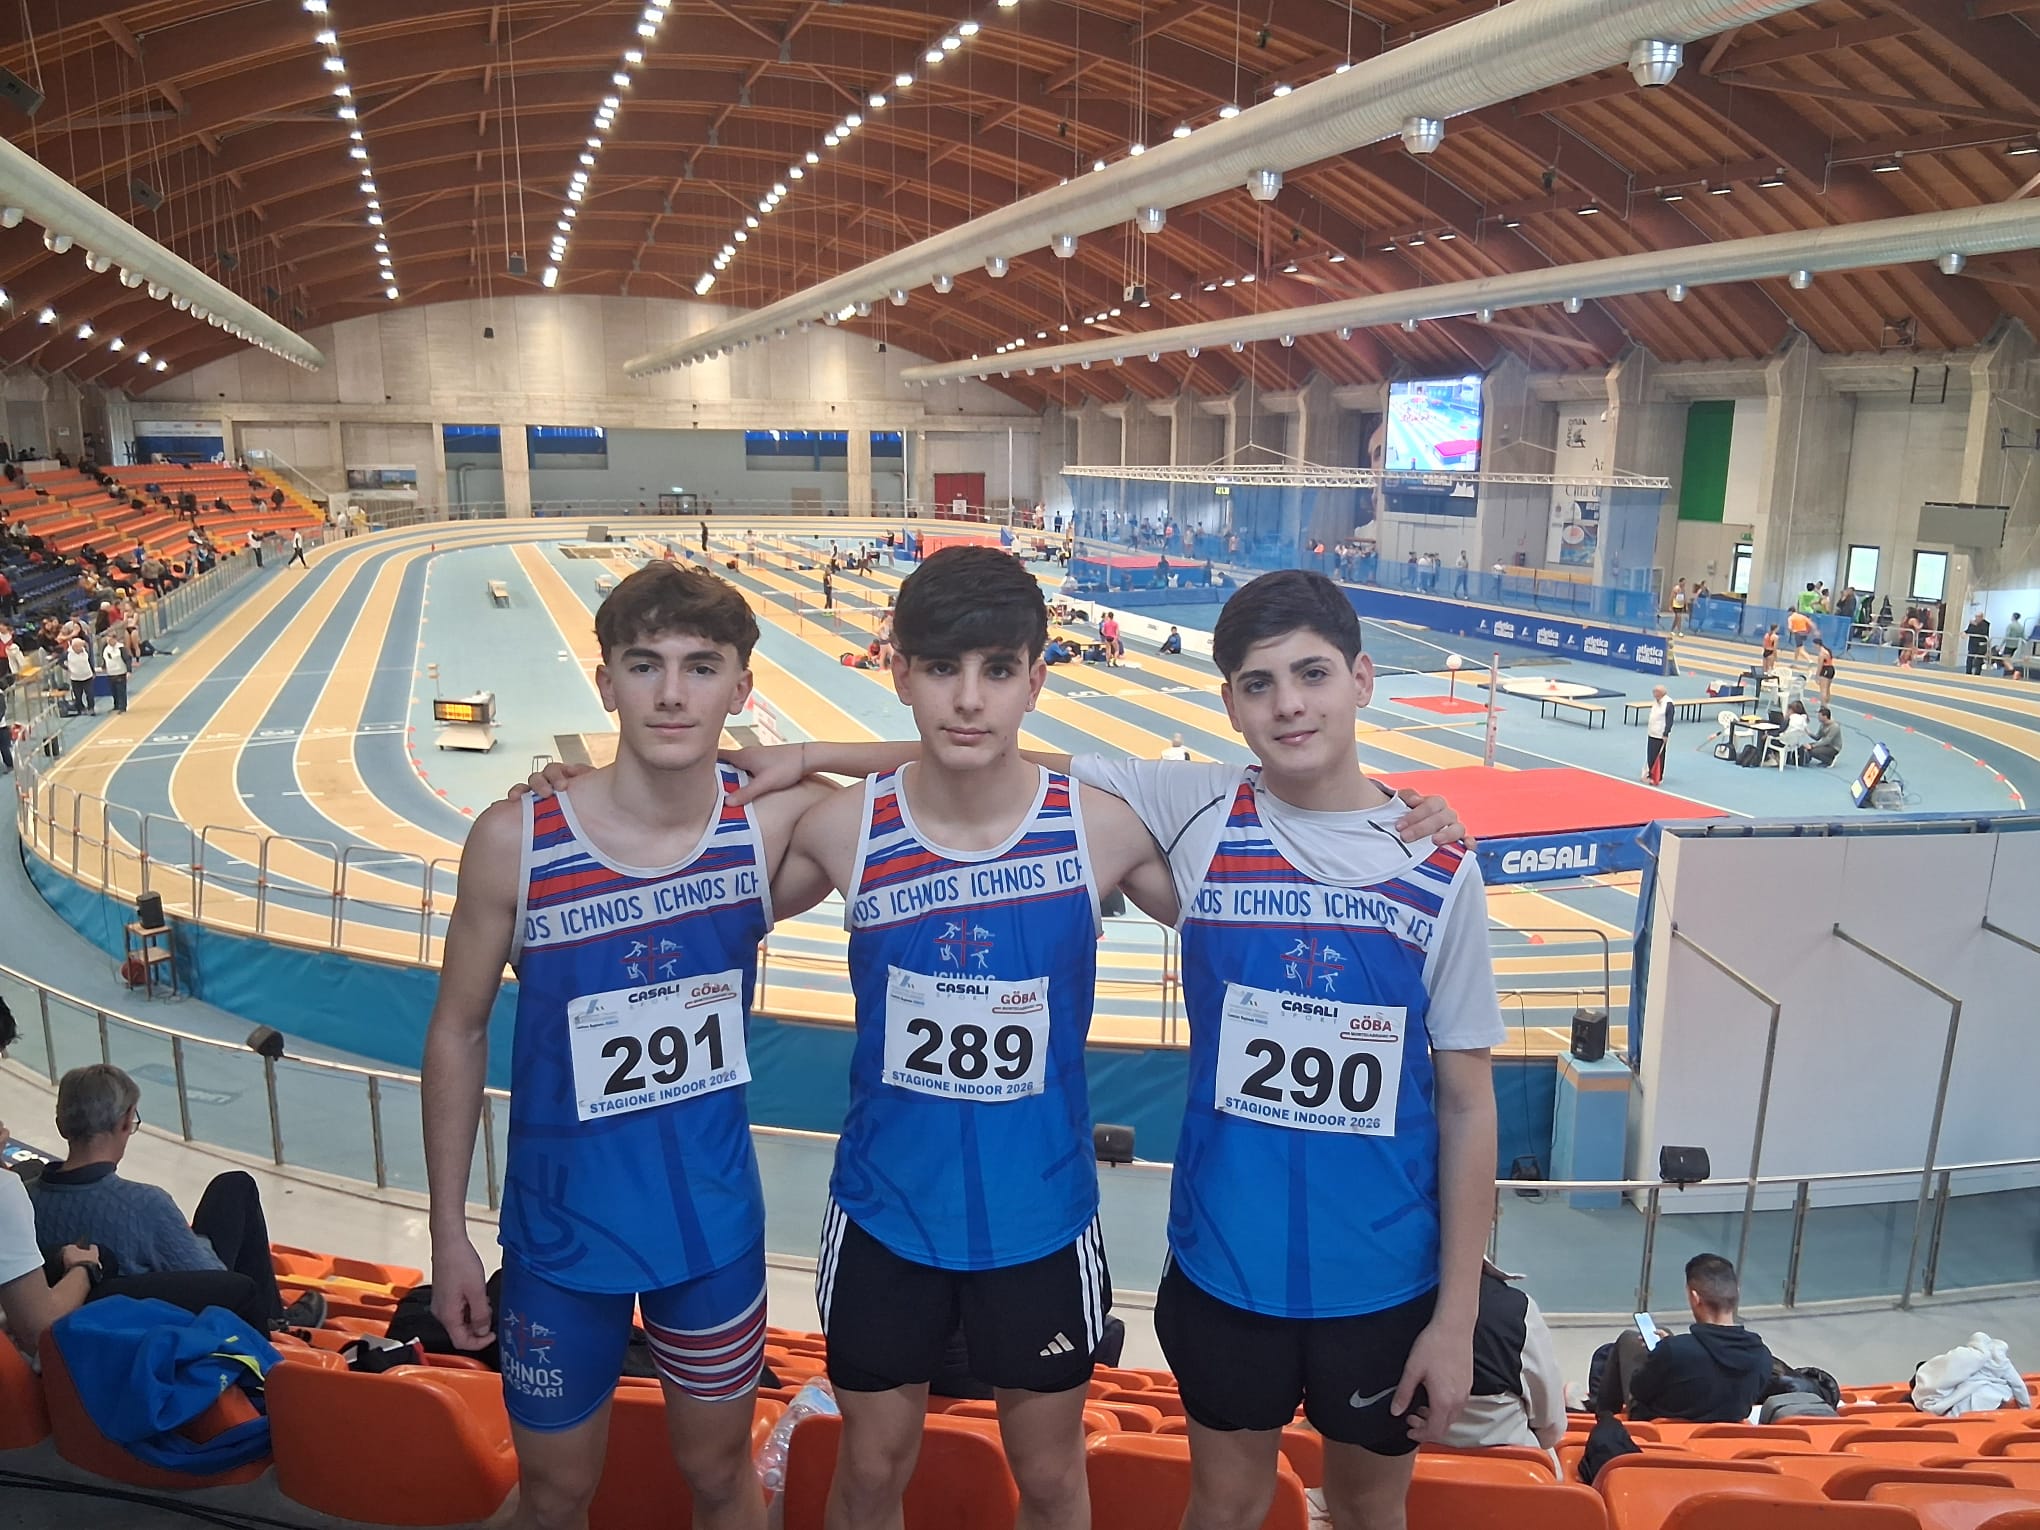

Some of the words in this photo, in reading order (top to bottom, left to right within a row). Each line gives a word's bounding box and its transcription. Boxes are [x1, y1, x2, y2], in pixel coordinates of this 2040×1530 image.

[1636, 644, 1664, 657] atletica
[1502, 843, 1597, 874] CASALI
[890, 876, 959, 914] ICHNOS
[970, 863, 1046, 898] ICHNOS
[524, 915, 551, 941] OS
[561, 895, 643, 936] ICHNOS
[653, 877, 726, 915] ICHNOS
[1234, 890, 1311, 916] ICHNOS
[1325, 892, 1400, 927] ICHNOS
[628, 984, 680, 1003] CASALI
[936, 983, 989, 995] CASALI
[1281, 1000, 1339, 1018] CASALI
[601, 1013, 724, 1096] 291
[905, 1018, 1034, 1081] 289
[590, 1092, 656, 1114] STAGIONE
[660, 1079, 707, 1099] INDOOR
[709, 1070, 737, 1087] 2026
[892, 1070, 950, 1092] STAGIONE
[954, 1082, 1002, 1095] INDOOR
[1006, 1081, 1034, 1094] 2026
[1240, 1038, 1382, 1113] 290
[1225, 1096, 1290, 1121] STAGIONE
[1293, 1111, 1346, 1127] INDOOR
[1350, 1117, 1381, 1129] 2026
